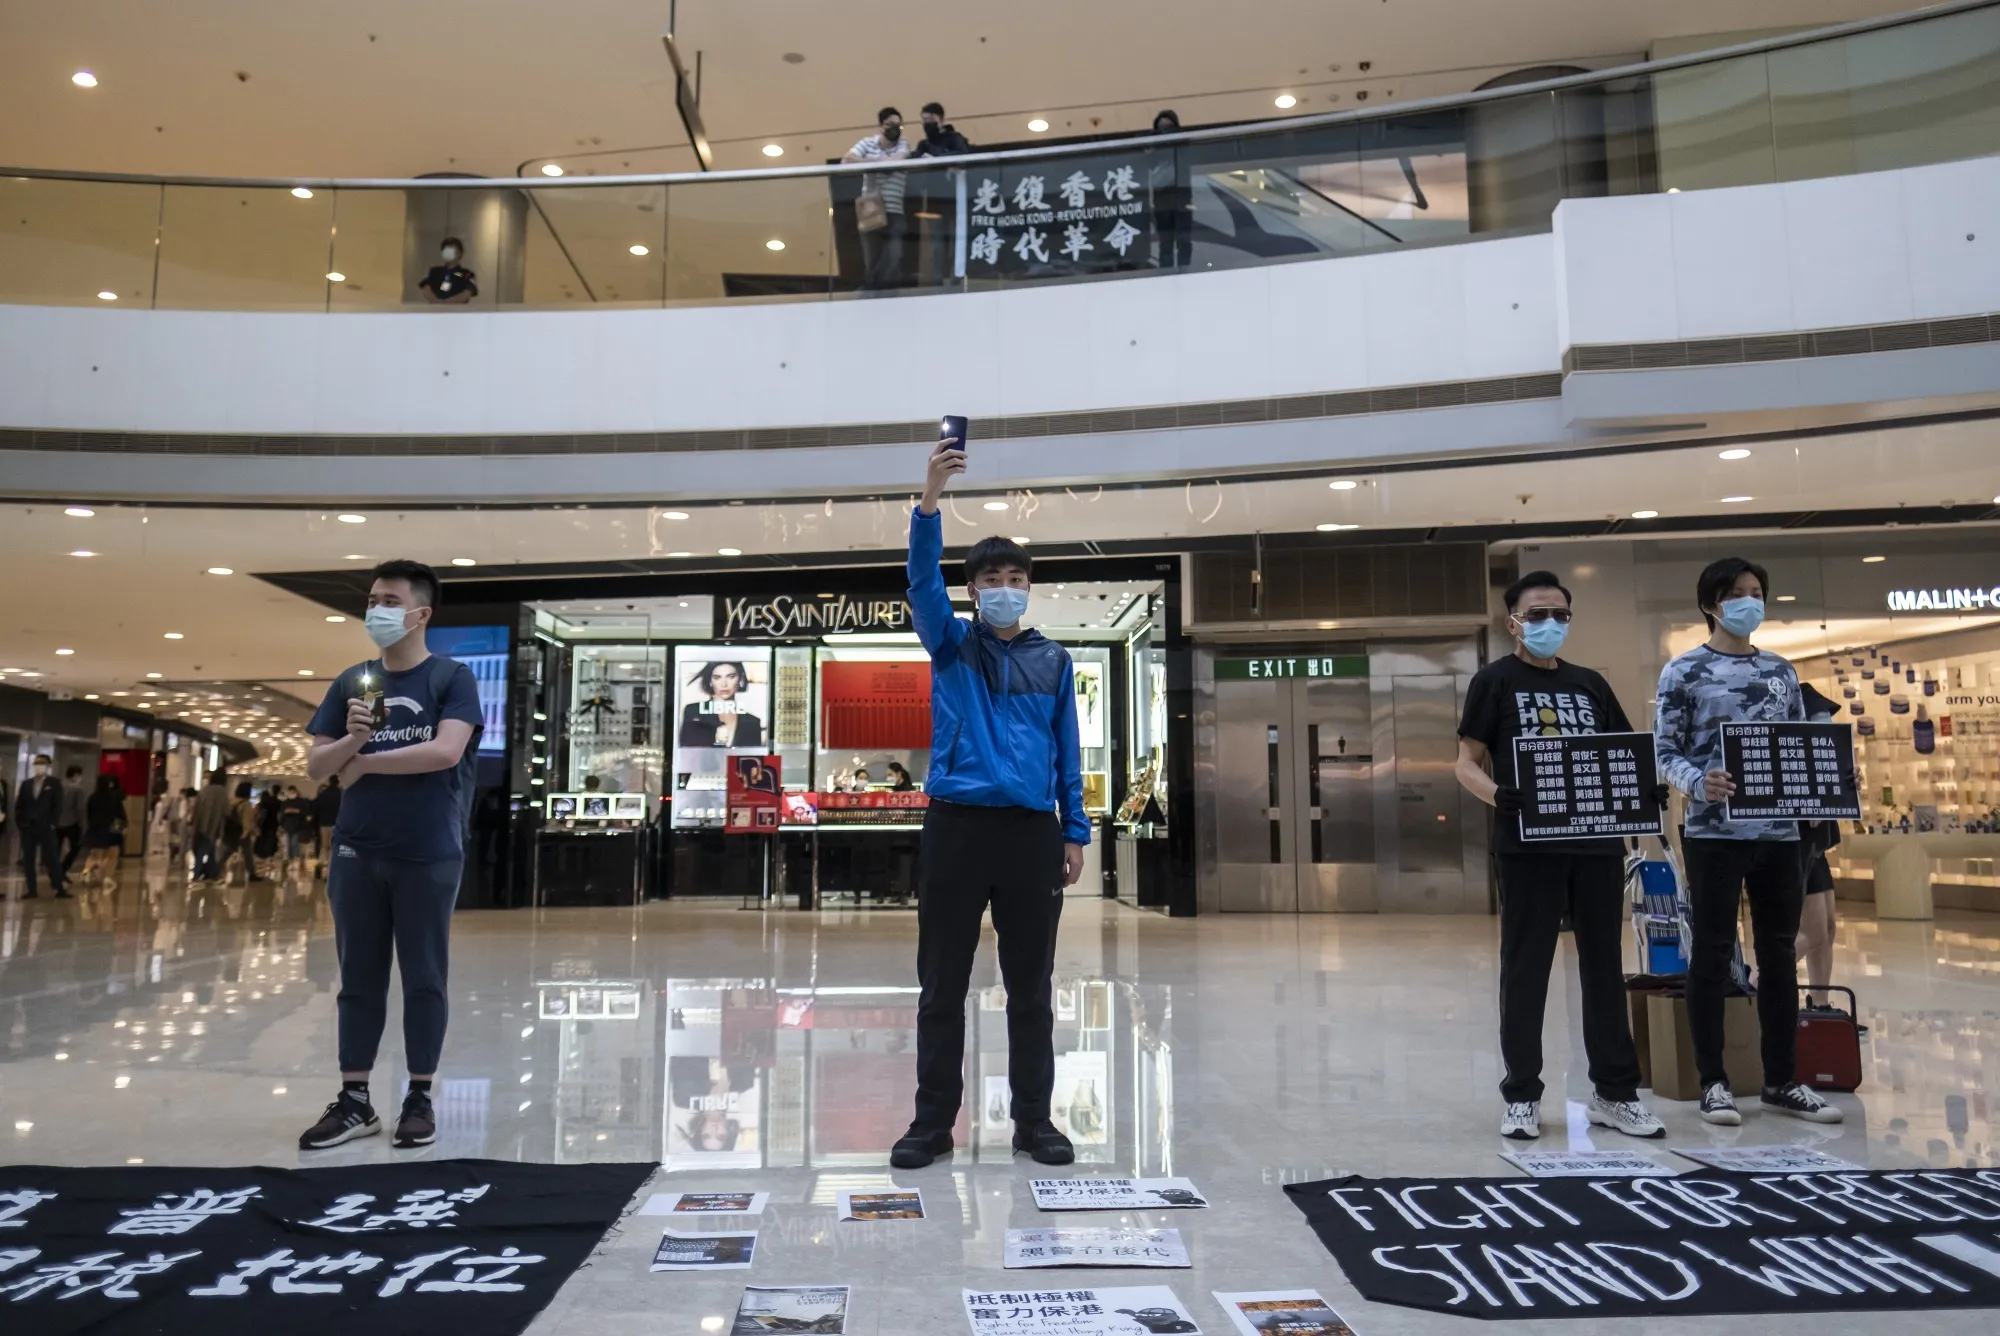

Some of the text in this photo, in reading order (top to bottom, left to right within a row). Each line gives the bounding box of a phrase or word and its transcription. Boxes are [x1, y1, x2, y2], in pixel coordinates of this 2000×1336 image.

[972, 165, 1141, 214] 光復香港
[971, 215, 995, 226] FREE
[997, 214, 1025, 227] HONG
[1119, 202, 1143, 216] NOW
[970, 219, 1141, 265] 時代革命
[1249, 659, 1296, 677] EXIT
[699, 701, 747, 715] LIBRE
[1515, 692, 1592, 710] FREE
[1946, 695, 1973, 705] arm
[1328, 1183, 1581, 1231] FIGHT
[1588, 1178, 1797, 1229] FOR
[1372, 1235, 1972, 1307] STAND WITH
[968, 1291, 1098, 1305] 抵制極權
[971, 1304, 1104, 1319] 奮力保港
[975, 1318, 1093, 1330] Fight for Freedom
[1068, 1326, 1104, 1336] Hong
